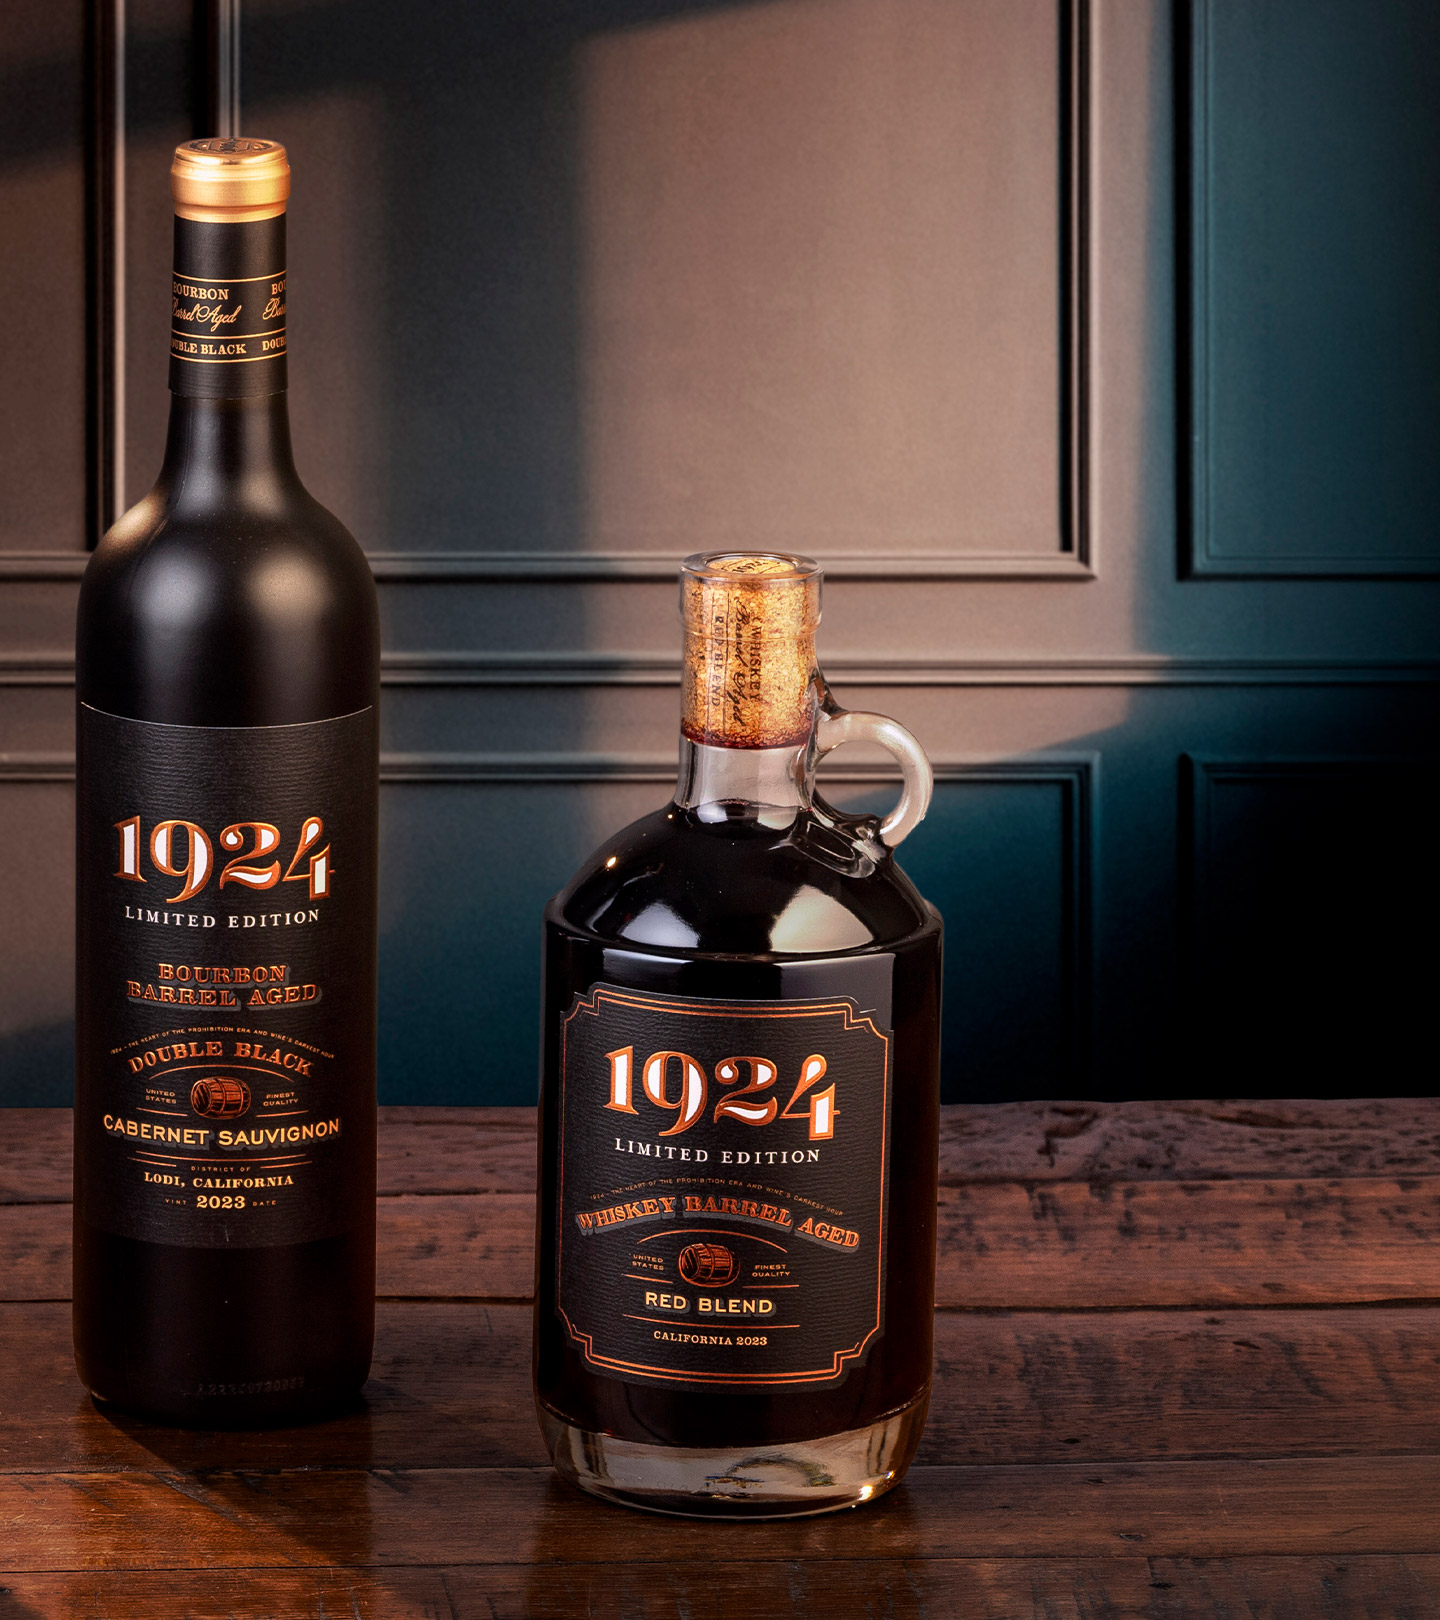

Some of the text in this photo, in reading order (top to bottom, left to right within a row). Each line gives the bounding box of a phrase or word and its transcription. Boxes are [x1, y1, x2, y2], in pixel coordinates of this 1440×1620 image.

[172, 282, 230, 300] BOURBON
[196, 305, 242, 332] Aged
[172, 339, 247, 355] OUBLE BLACK
[113, 815, 336, 903] 1924
[126, 905, 320, 929] LIMITED EDITION
[158, 963, 287, 983] BOURBON
[127, 980, 320, 1006] BARREL AGED
[127, 1041, 316, 1078] DOUBLE BLACK
[145, 1088, 176, 1097] UNITED
[603, 1045, 841, 1141] 1924
[103, 1114, 340, 1146] CABERNET SAUVIGNON
[615, 1138, 821, 1165] LIMITED EDITION
[144, 1172, 295, 1190] LODI, CALIFORNIA
[625, 1182, 646, 1192] HEART
[676, 1177, 725, 1185] PROHIBITION
[196, 1196, 246, 1210] 2023
[576, 1196, 860, 1248] WHISKEY BARREL AGED
[631, 1261, 665, 1271] STATES
[632, 1254, 664, 1264] UNITED
[754, 1263, 787, 1271] FINEST
[645, 1292, 773, 1314] RED BLEND
[653, 1331, 768, 1347] CALIFORNIA 2023
